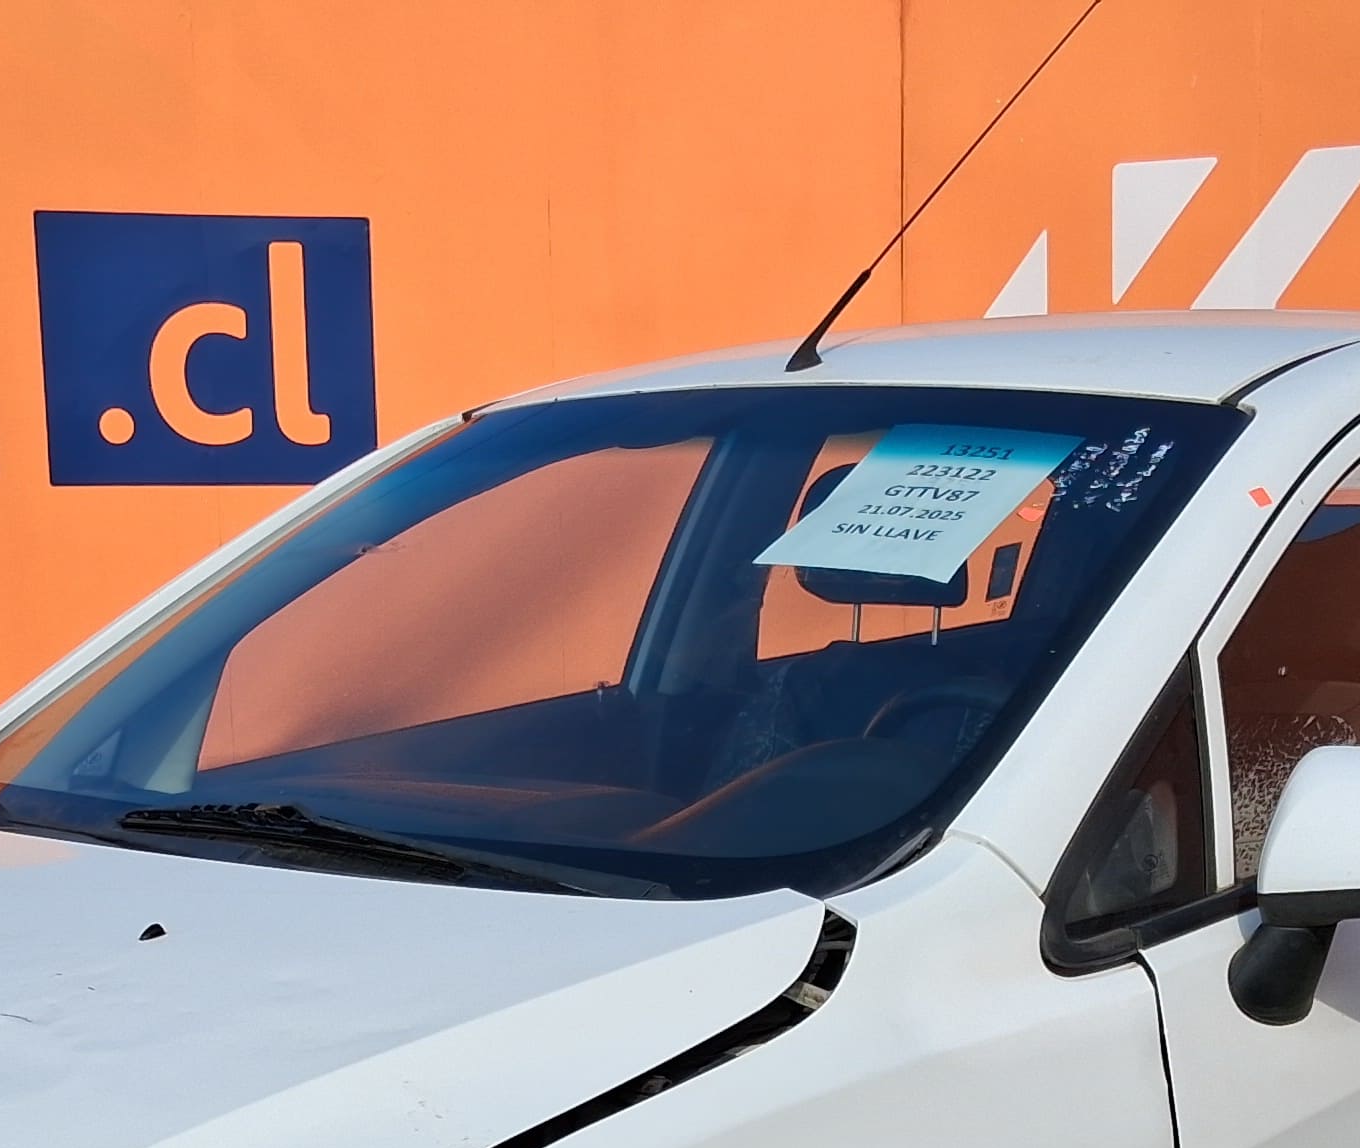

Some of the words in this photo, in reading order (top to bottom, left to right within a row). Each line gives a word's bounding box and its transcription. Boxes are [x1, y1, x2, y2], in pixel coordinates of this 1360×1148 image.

[97, 241, 332, 447] .cl
[941, 443, 1013, 461] 13251
[906, 464, 997, 481] 223122
[885, 485, 980, 503] GTTV87
[858, 504, 965, 521] 21.07.2025
[832, 522, 869, 536] SIN
[874, 524, 944, 542] LLAVE
